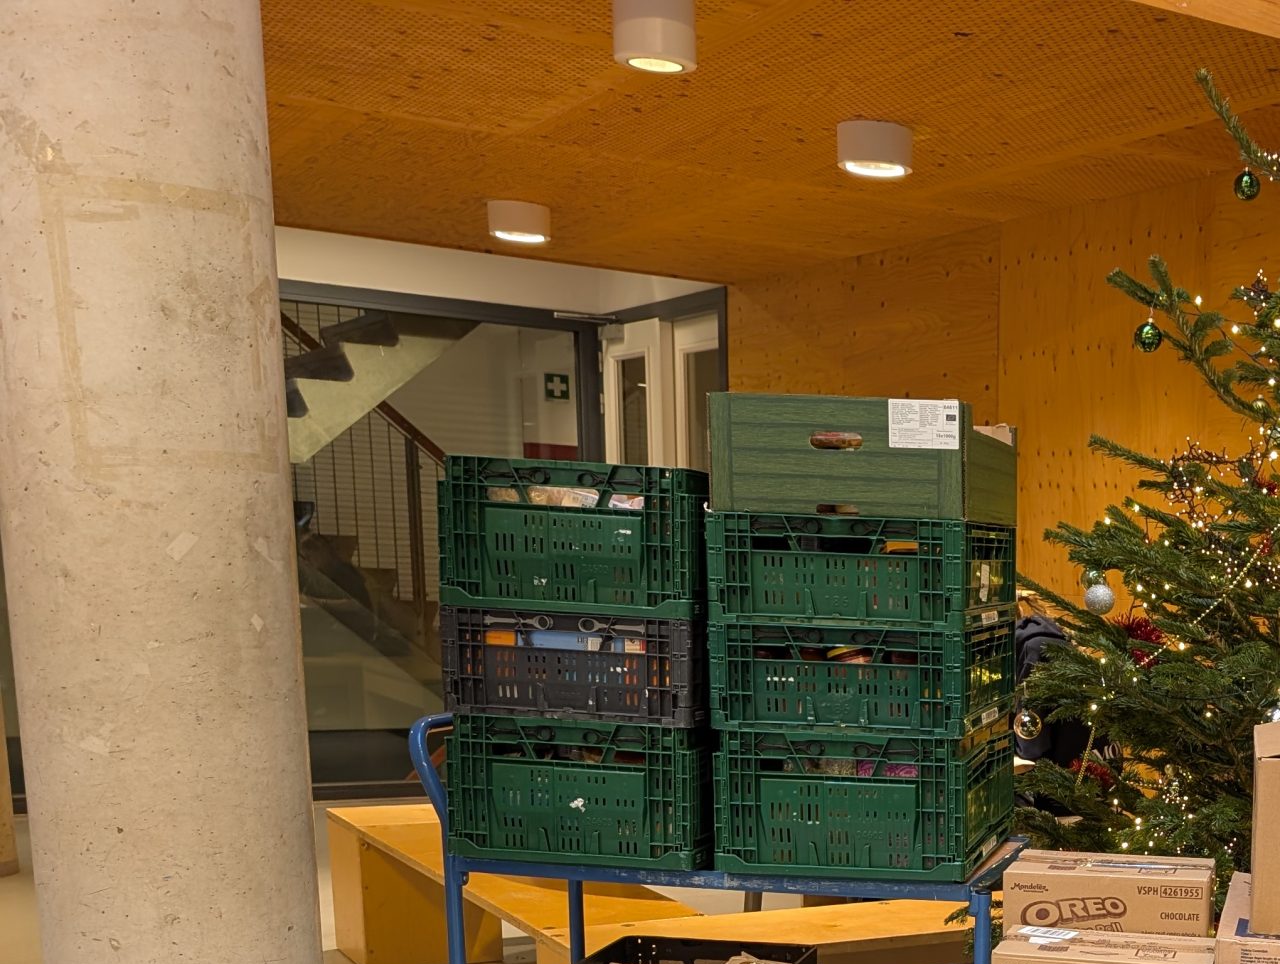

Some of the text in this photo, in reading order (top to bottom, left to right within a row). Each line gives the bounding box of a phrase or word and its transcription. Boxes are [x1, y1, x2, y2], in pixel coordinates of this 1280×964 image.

[1137, 886, 1200, 898] VSPH 4261955
[1021, 896, 1127, 926] OREO
[1160, 911, 1200, 922] CHOCOLATE
